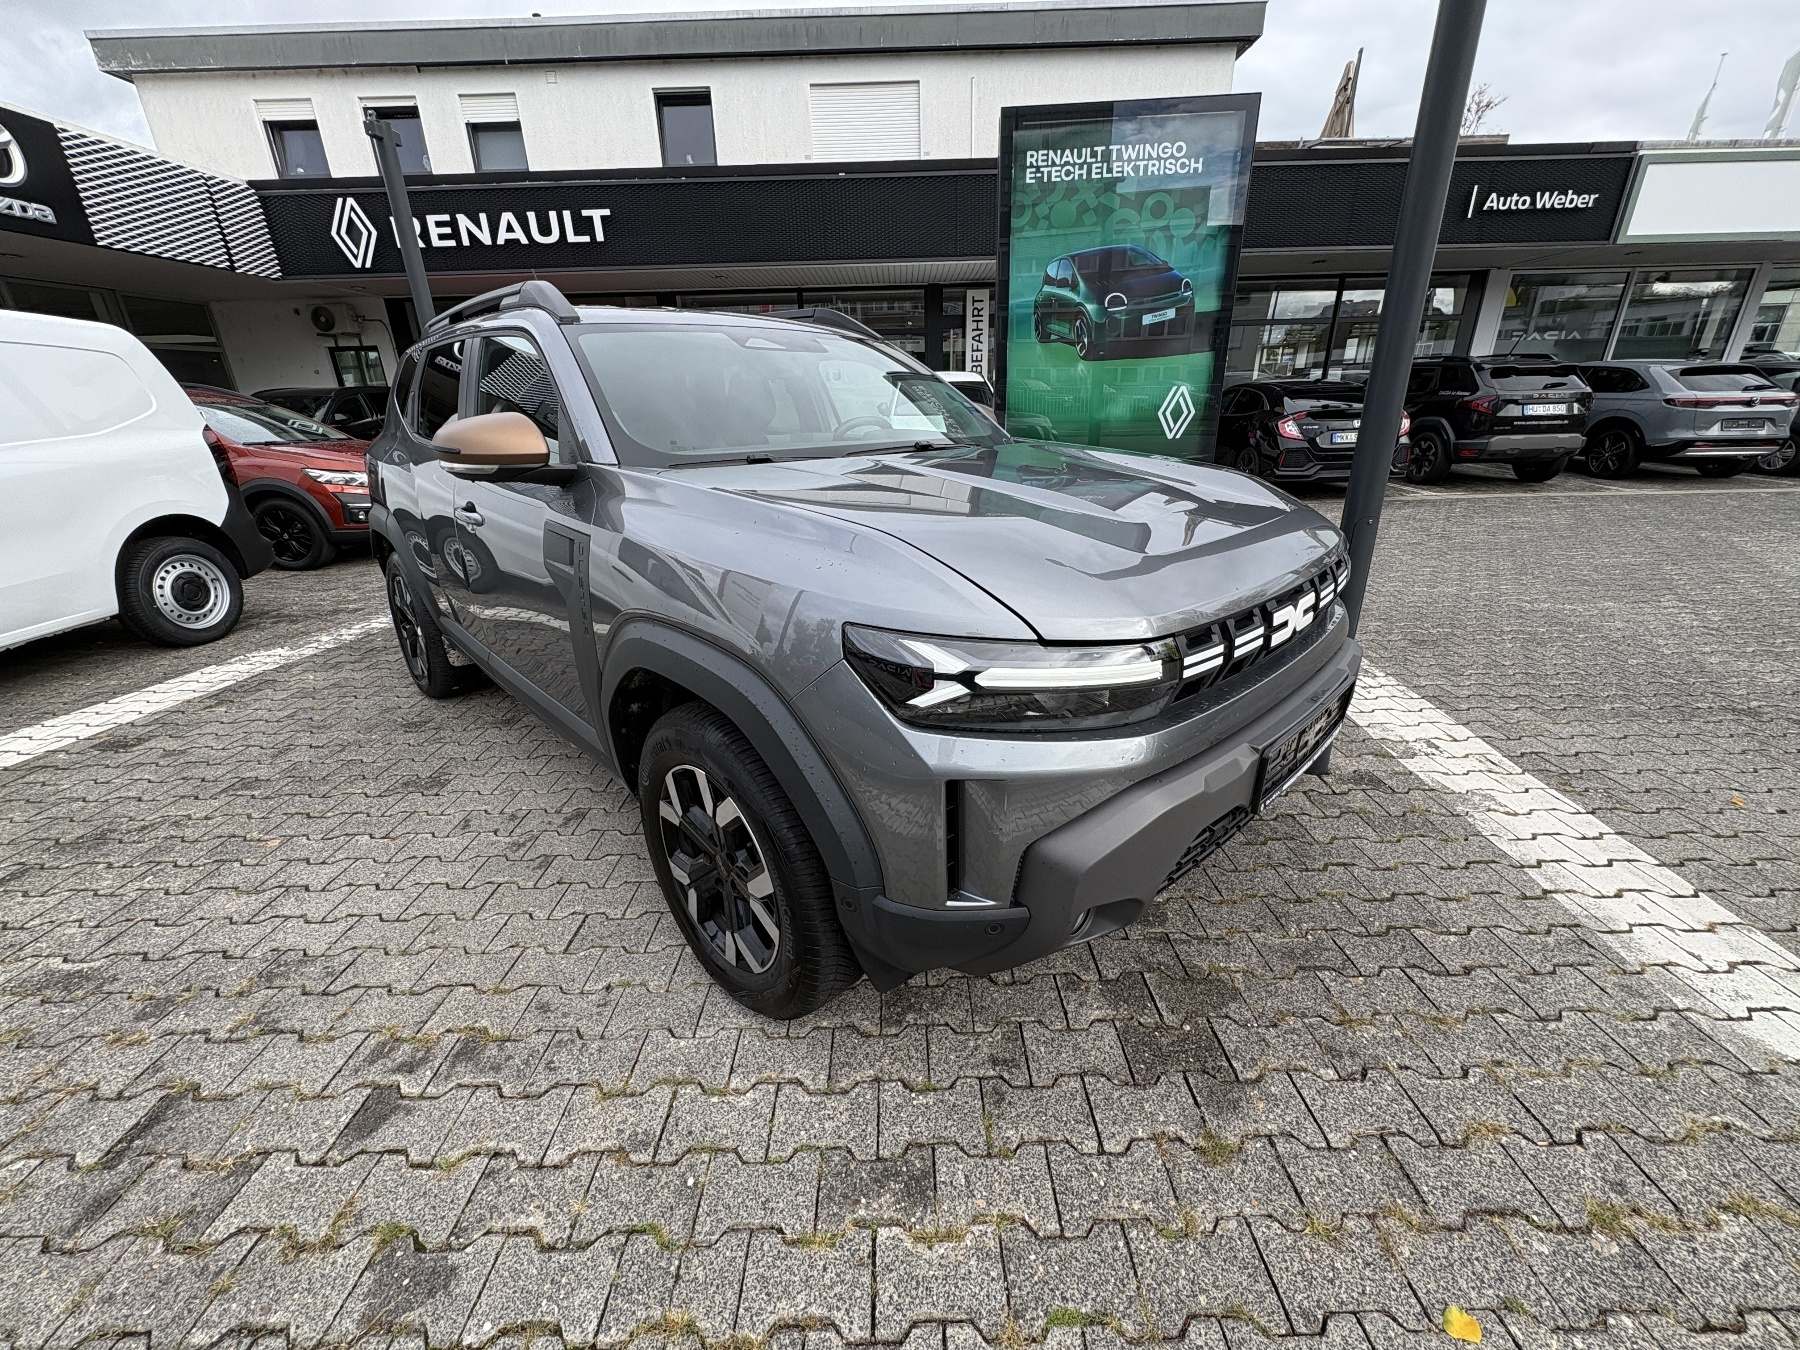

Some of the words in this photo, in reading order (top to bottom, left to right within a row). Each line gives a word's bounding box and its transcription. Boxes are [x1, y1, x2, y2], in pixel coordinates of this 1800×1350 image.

[1026, 146, 1106, 167] RENAULT
[1109, 142, 1187, 162] TWINGO
[1026, 164, 1088, 184] E-TECH
[1091, 158, 1203, 180] ELEKTRISCH
[1483, 191, 1531, 212] Auto
[1535, 189, 1599, 210] Weber
[970, 295, 985, 374] BEFAHRT
